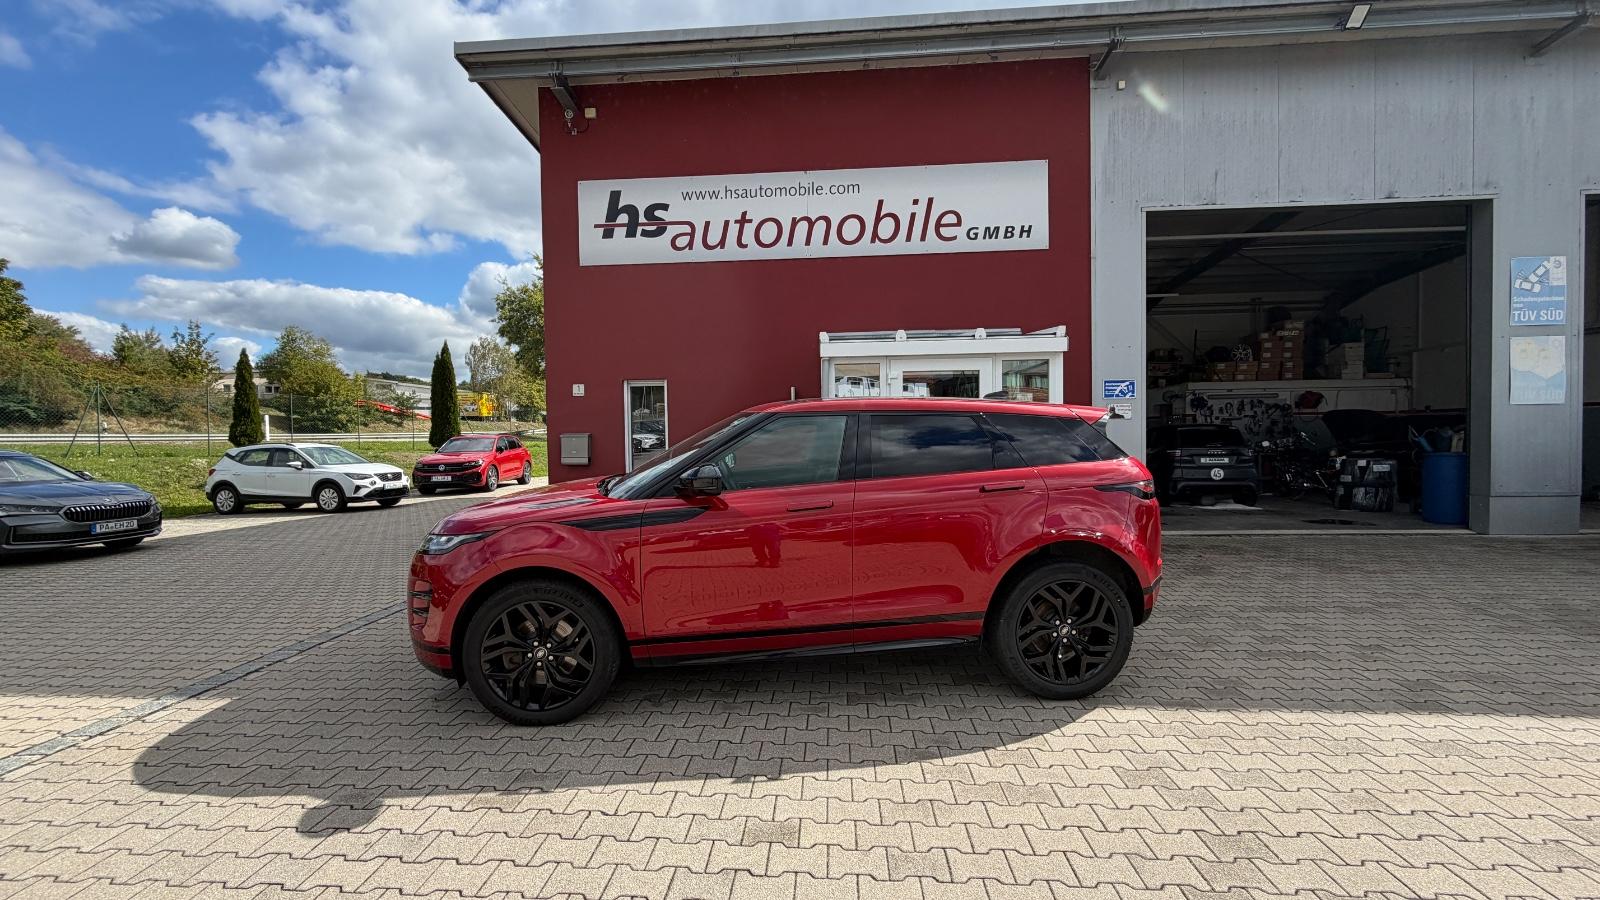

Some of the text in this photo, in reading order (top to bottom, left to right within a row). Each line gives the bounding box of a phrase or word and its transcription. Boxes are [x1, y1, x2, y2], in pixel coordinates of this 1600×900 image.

[681, 181, 860, 201] www.hsautomobile.com
[601, 190, 1033, 252] hs automobile GMBH
[1513, 307, 1564, 322] TÜV SÜD
